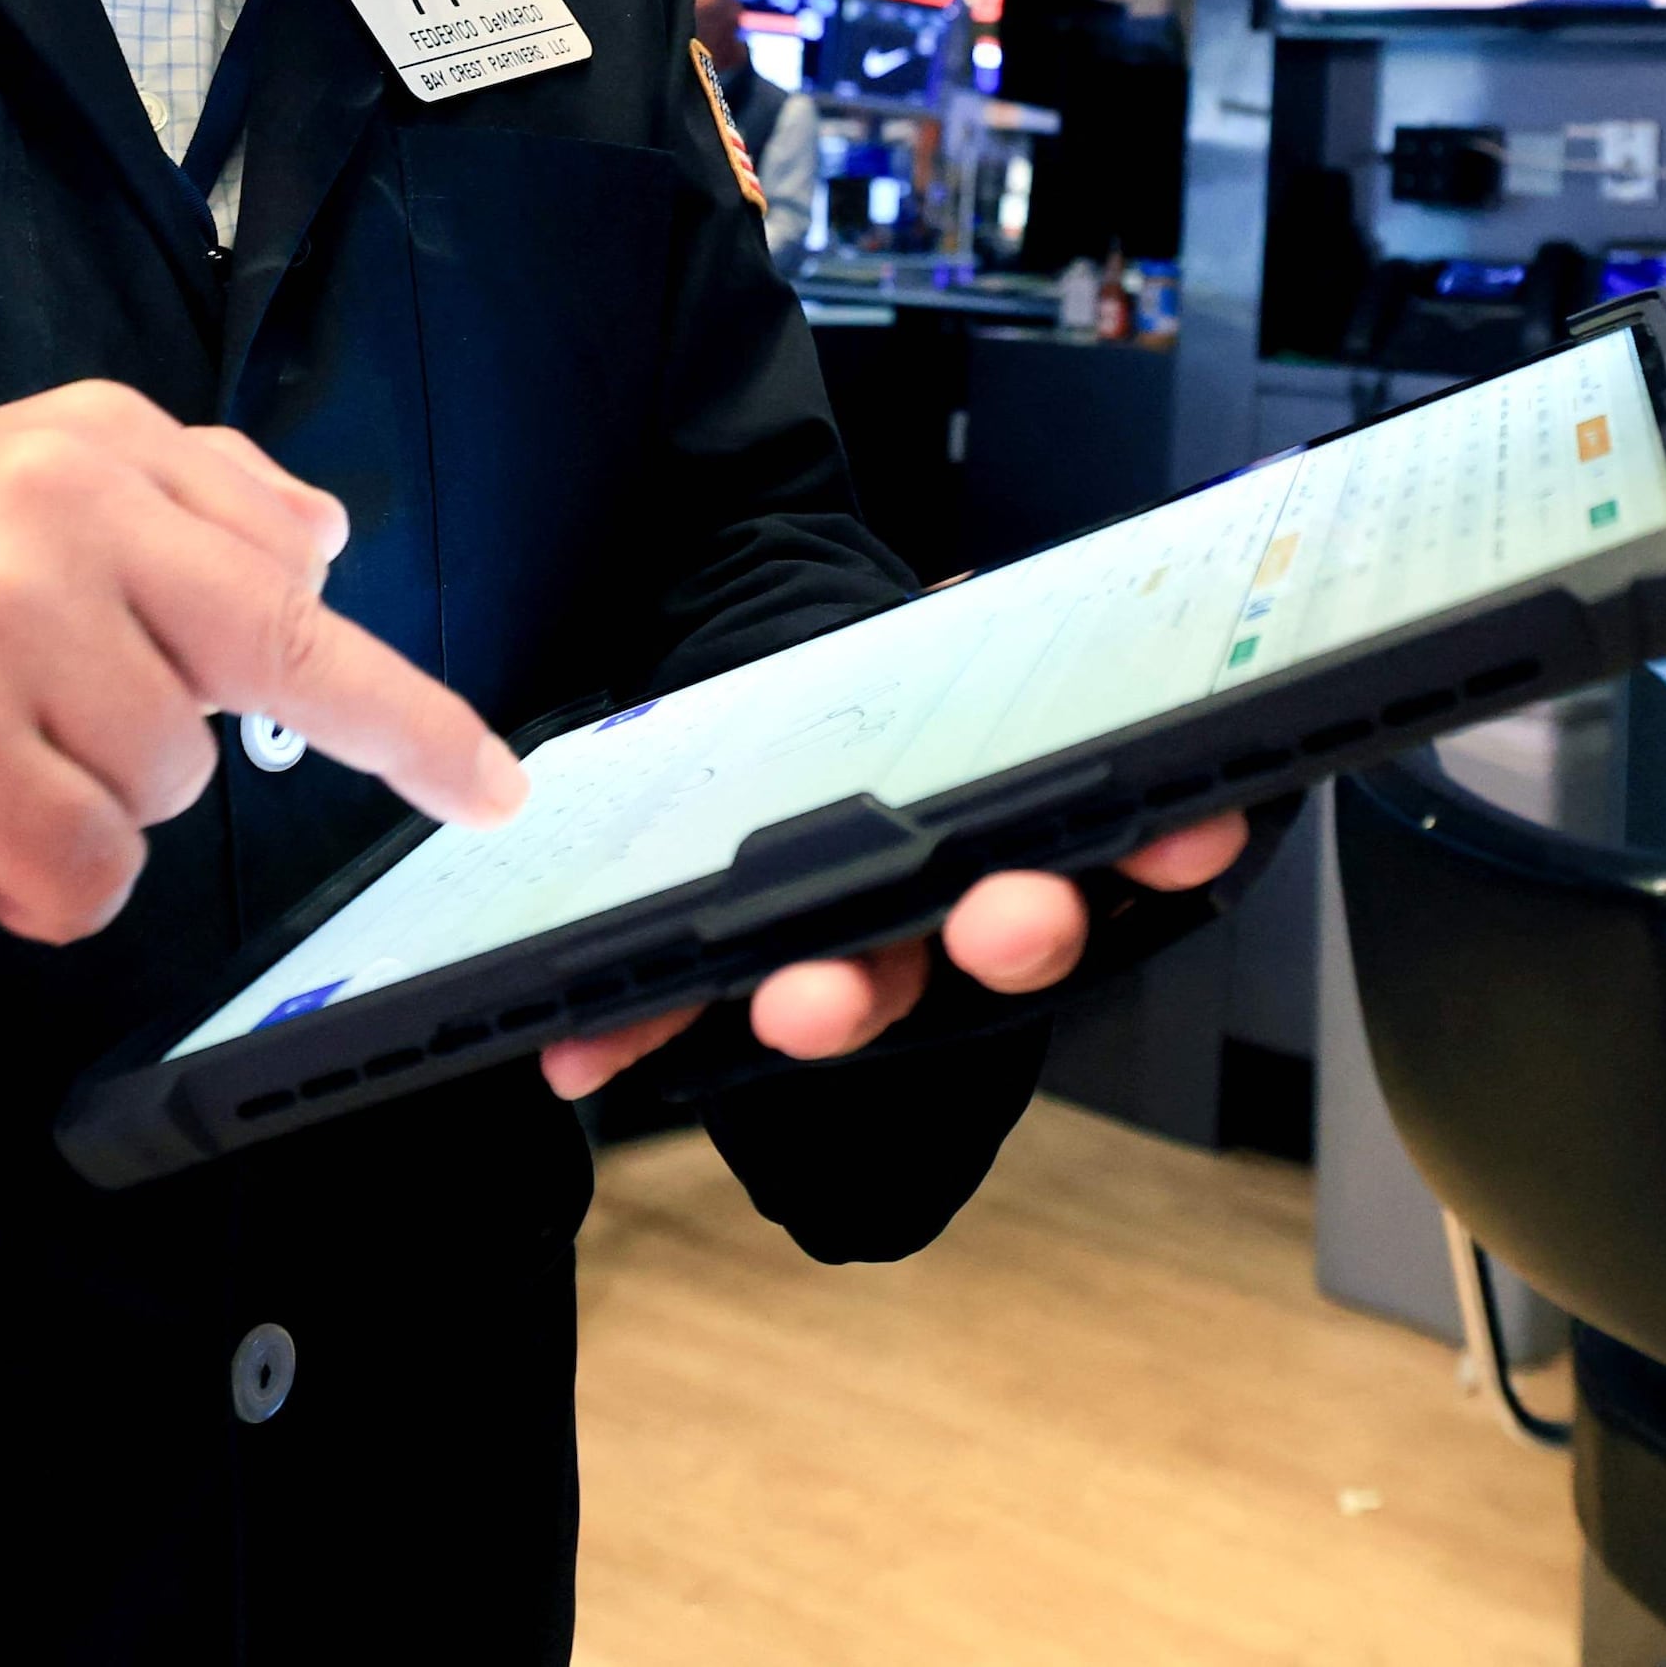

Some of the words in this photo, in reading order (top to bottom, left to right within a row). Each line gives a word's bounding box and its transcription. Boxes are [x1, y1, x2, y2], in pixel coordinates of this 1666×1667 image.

[409, 19, 479, 51] FEDERICO
[479, 4, 544, 34] DeMARCO
[420, 72, 447, 92] BAY
[449, 62, 489, 84] CREST
[547, 37, 572, 56] LLC
